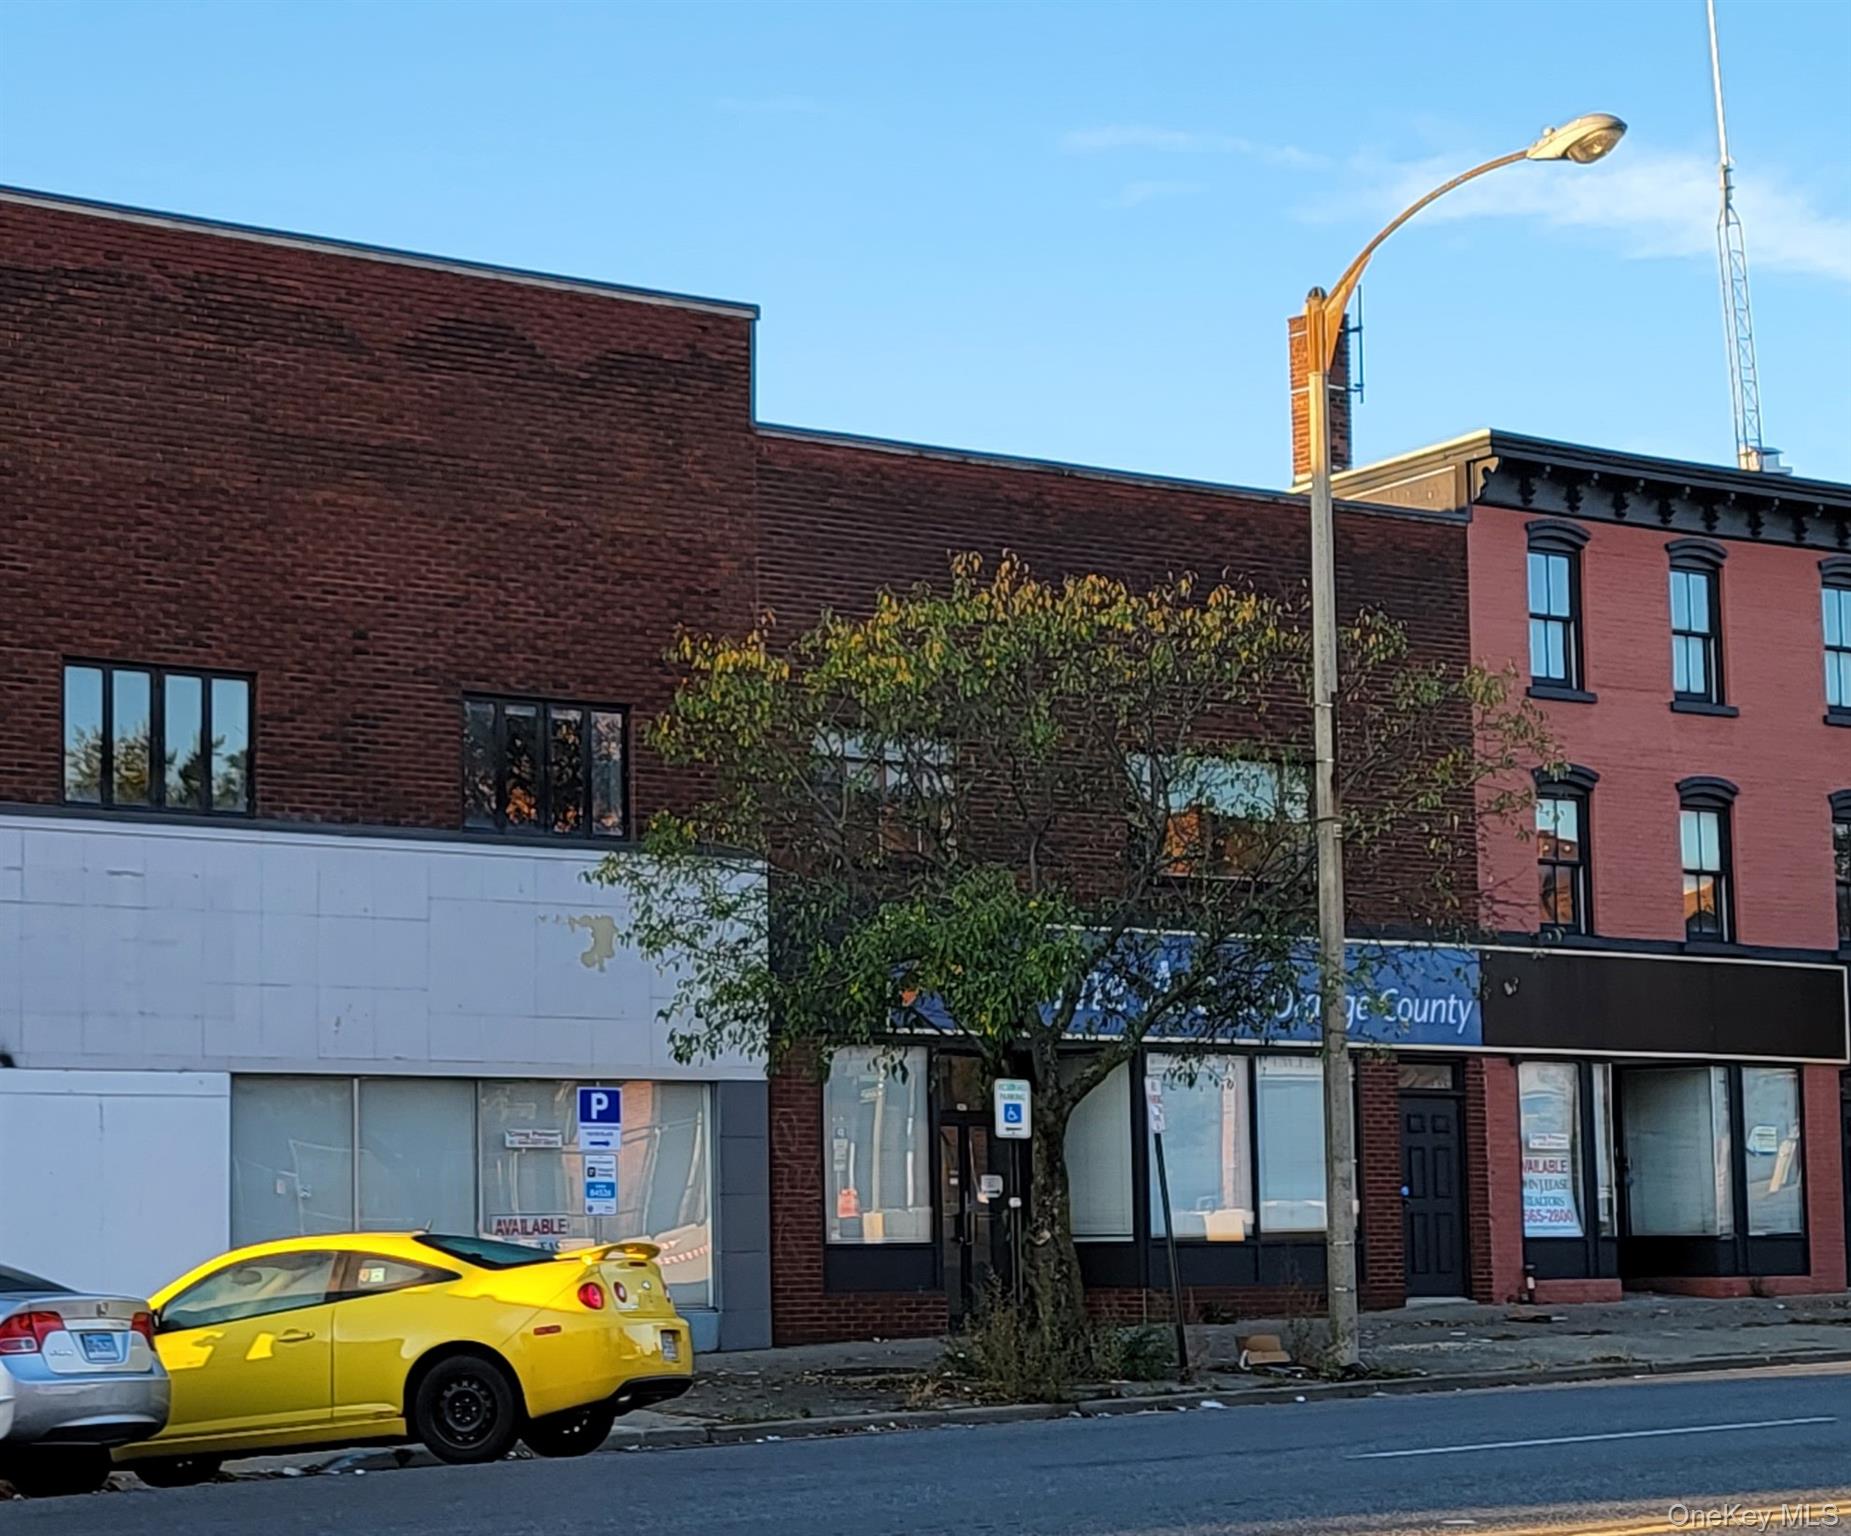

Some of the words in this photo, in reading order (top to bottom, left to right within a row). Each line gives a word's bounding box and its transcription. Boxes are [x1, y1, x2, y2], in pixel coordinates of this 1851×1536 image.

[1380, 988, 1473, 1034] County
[591, 1092, 609, 1120] P
[495, 1218, 567, 1236] AVAILABLE
